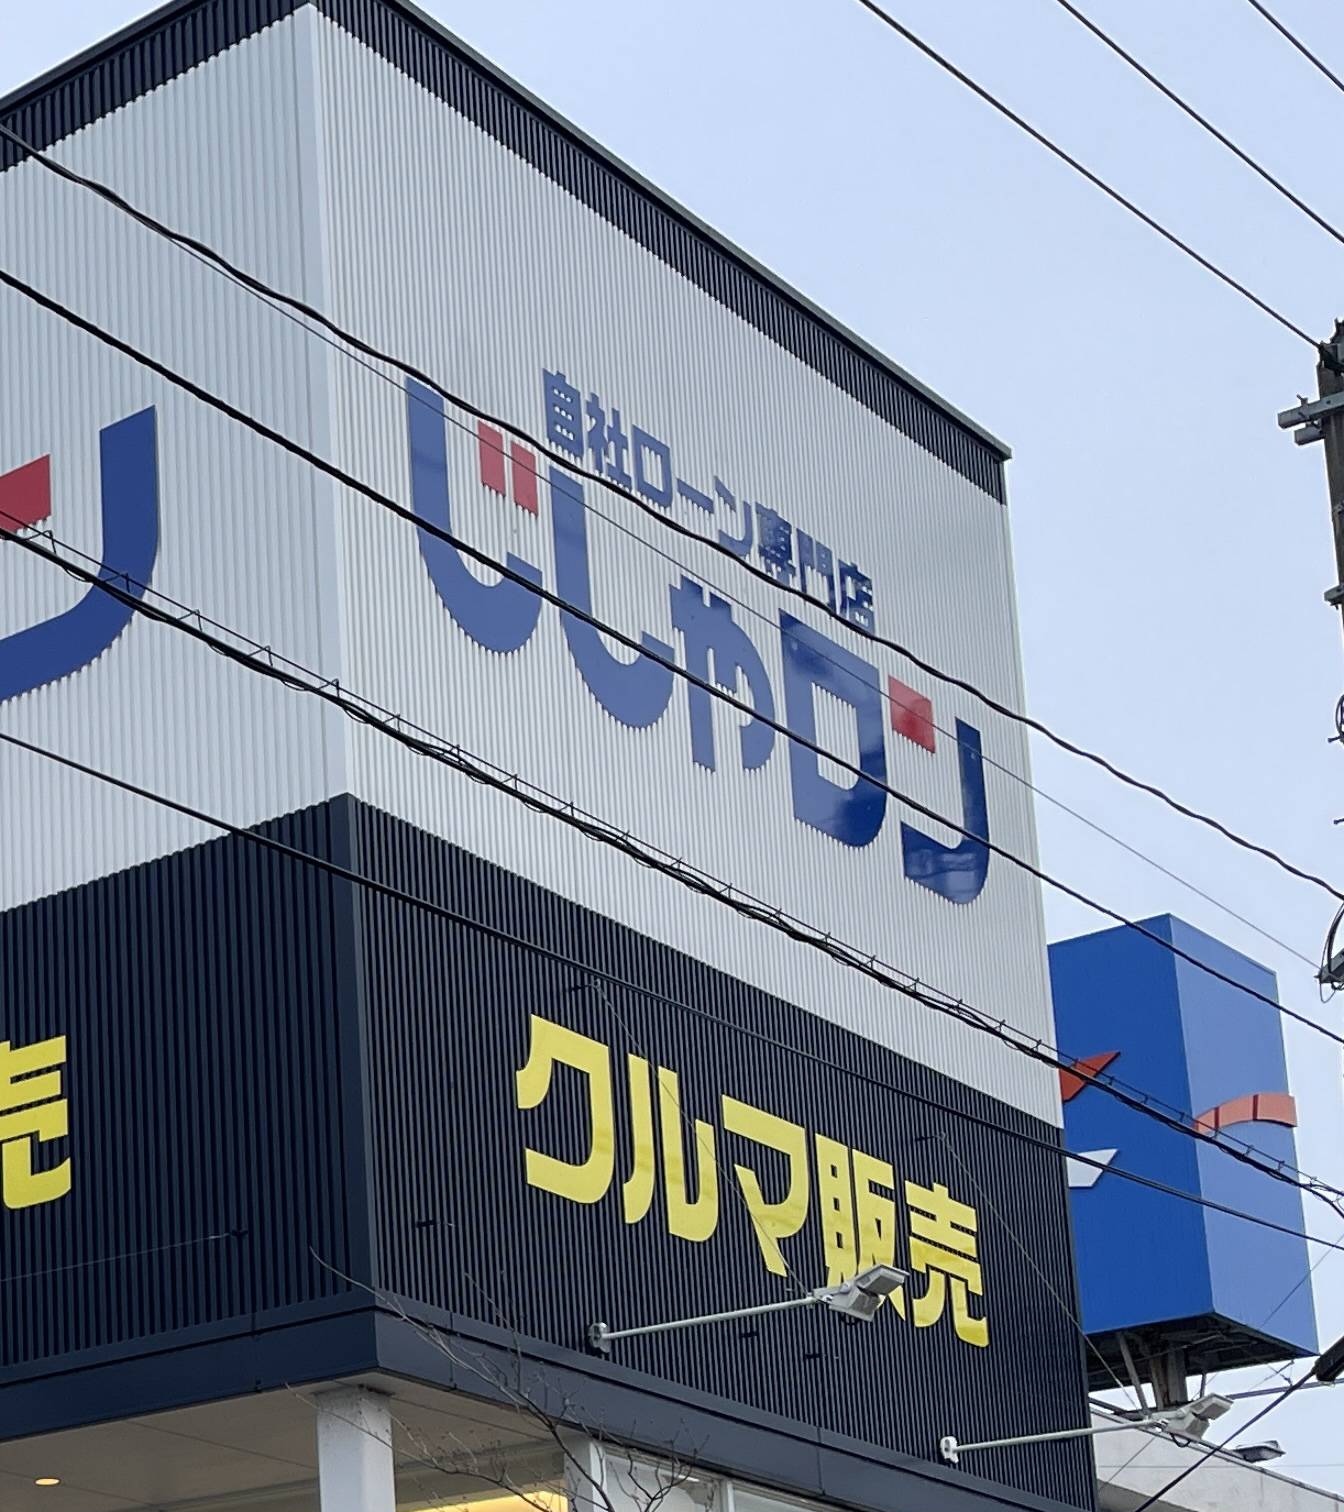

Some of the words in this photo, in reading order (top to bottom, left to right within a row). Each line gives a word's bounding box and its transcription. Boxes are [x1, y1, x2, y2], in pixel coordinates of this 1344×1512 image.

[405, 375, 990, 906] じしゃロン
[543, 367, 877, 632] 自社ローン専門店
[515, 1013, 990, 1350] クルマ販売
